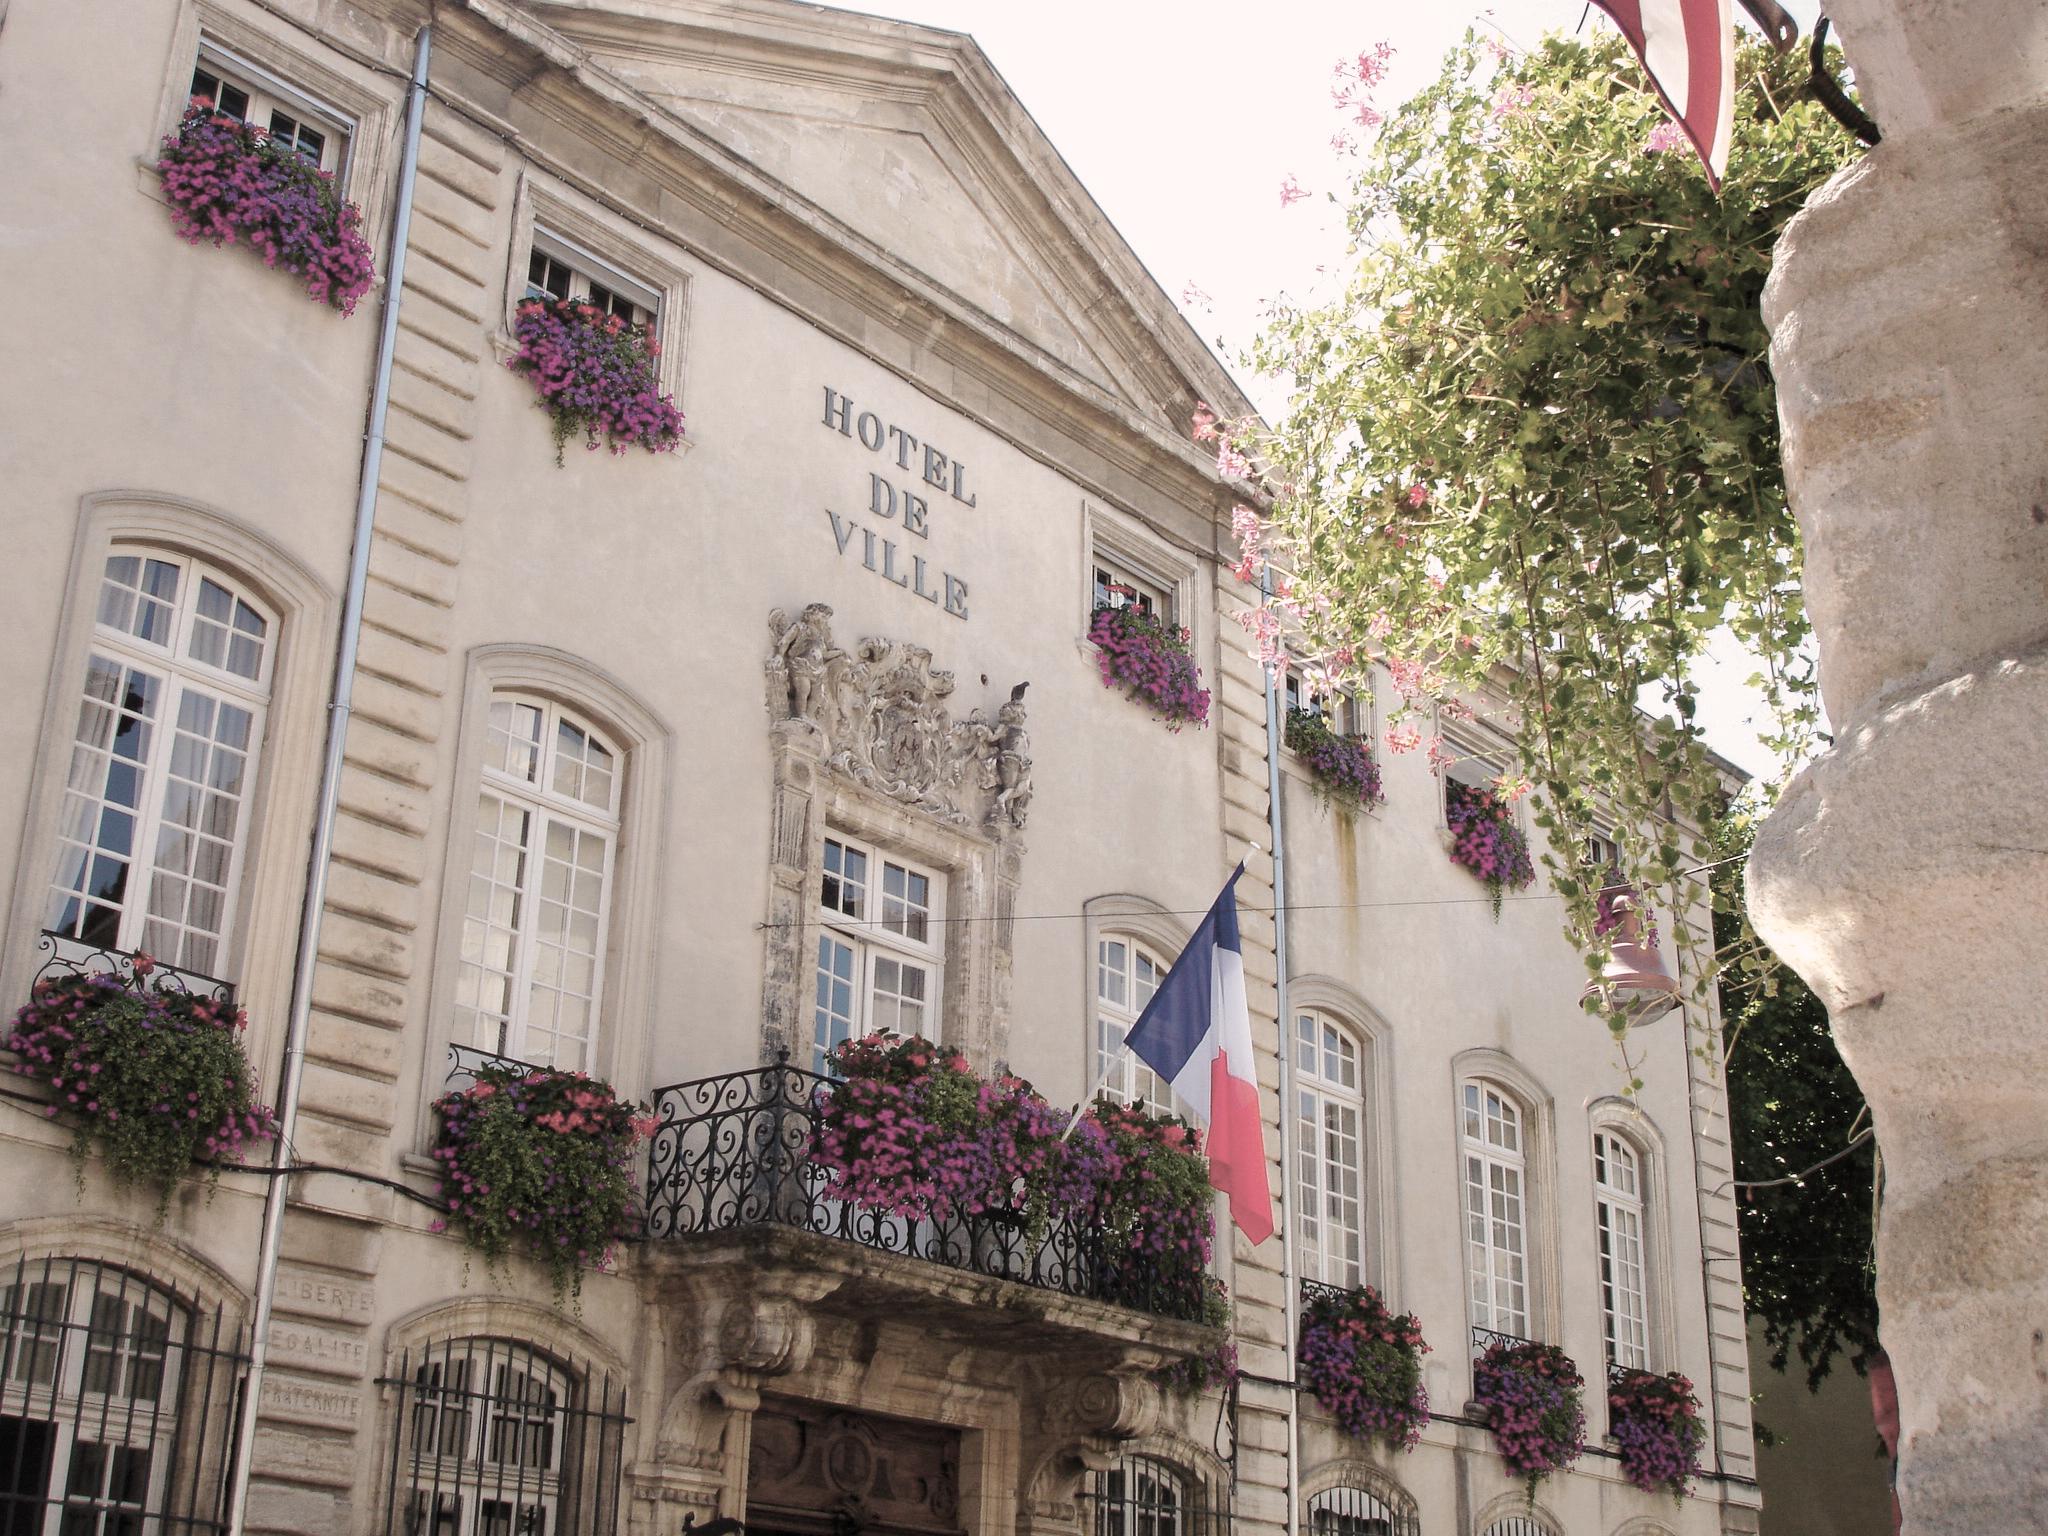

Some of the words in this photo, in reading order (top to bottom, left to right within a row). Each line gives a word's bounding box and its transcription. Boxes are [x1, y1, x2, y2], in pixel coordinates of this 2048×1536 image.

[822, 385, 976, 508] HOTEL
[868, 472, 928, 540] DE
[825, 509, 969, 621] VILLE
